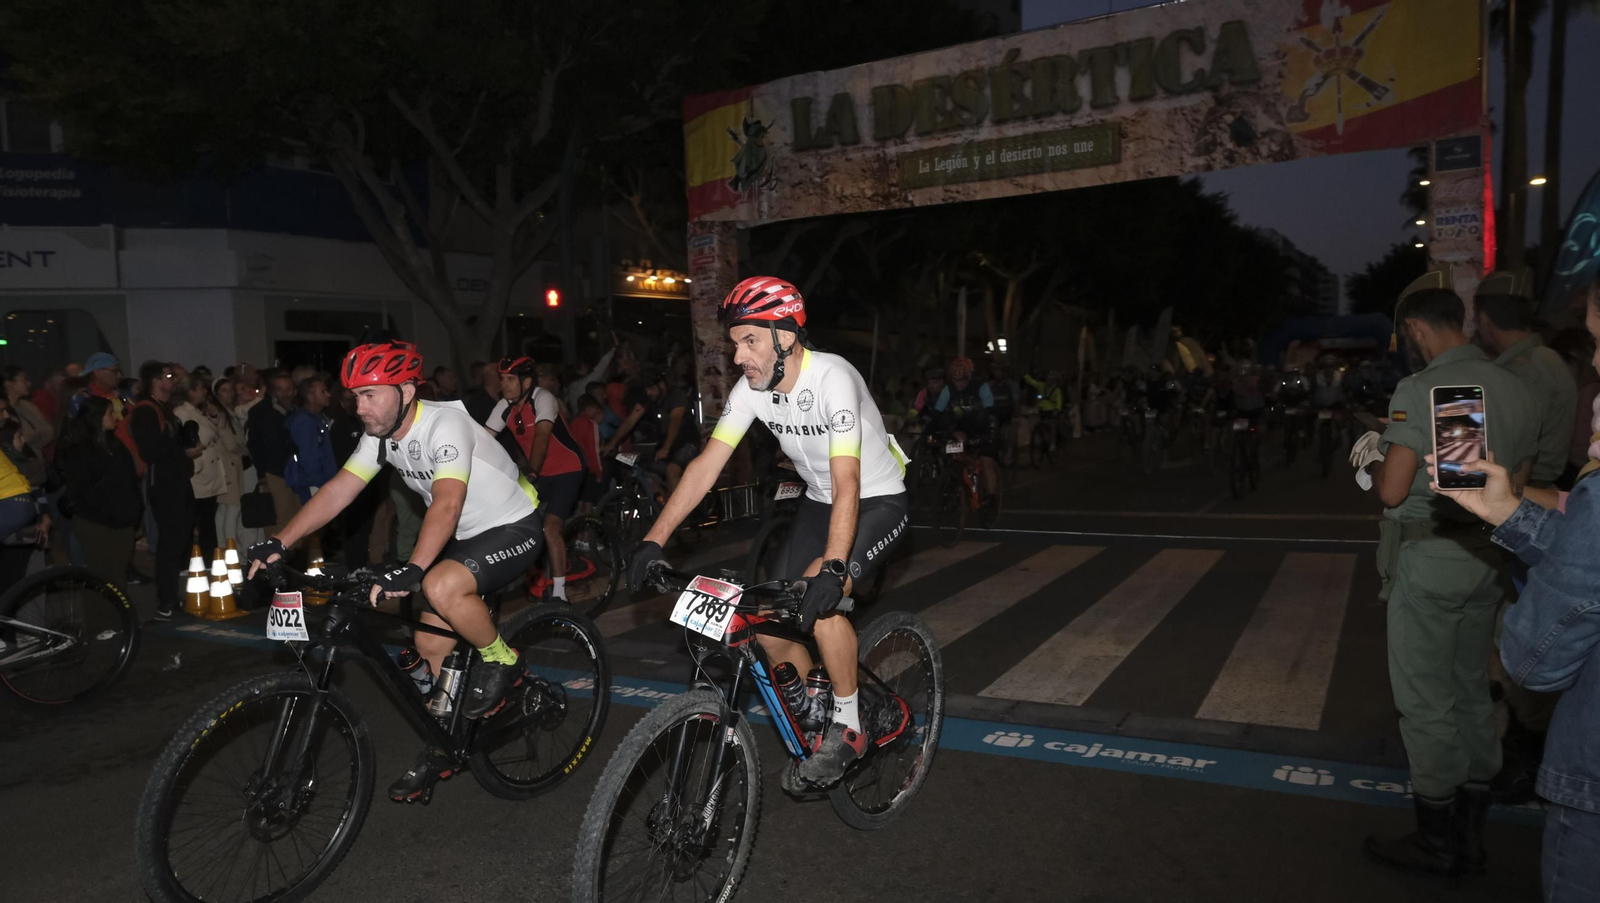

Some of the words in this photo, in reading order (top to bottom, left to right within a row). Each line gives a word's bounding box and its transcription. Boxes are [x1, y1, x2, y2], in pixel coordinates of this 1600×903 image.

[790, 92, 861, 152] LA
[871, 20, 1262, 141] DESÉRTICA
[918, 159, 930, 174] La
[934, 154, 968, 173] Legión
[973, 155, 981, 170] y
[985, 150, 995, 165] el
[1000, 146, 1043, 163] desierto
[1048, 142, 1068, 157] nos
[1073, 140, 1094, 154] une
[0, 185, 82, 200] isioterapia
[1436, 214, 1479, 226] RENTA
[761, 421, 829, 436] EGALBIK
[485, 537, 536, 565] SEGALBIKE
[866, 514, 909, 561] SEGALBIKE
[270, 607, 302, 628] 9022
[686, 591, 729, 622] 7369
[564, 735, 592, 774] MAXXIS
[1043, 741, 1217, 769] cajamar
